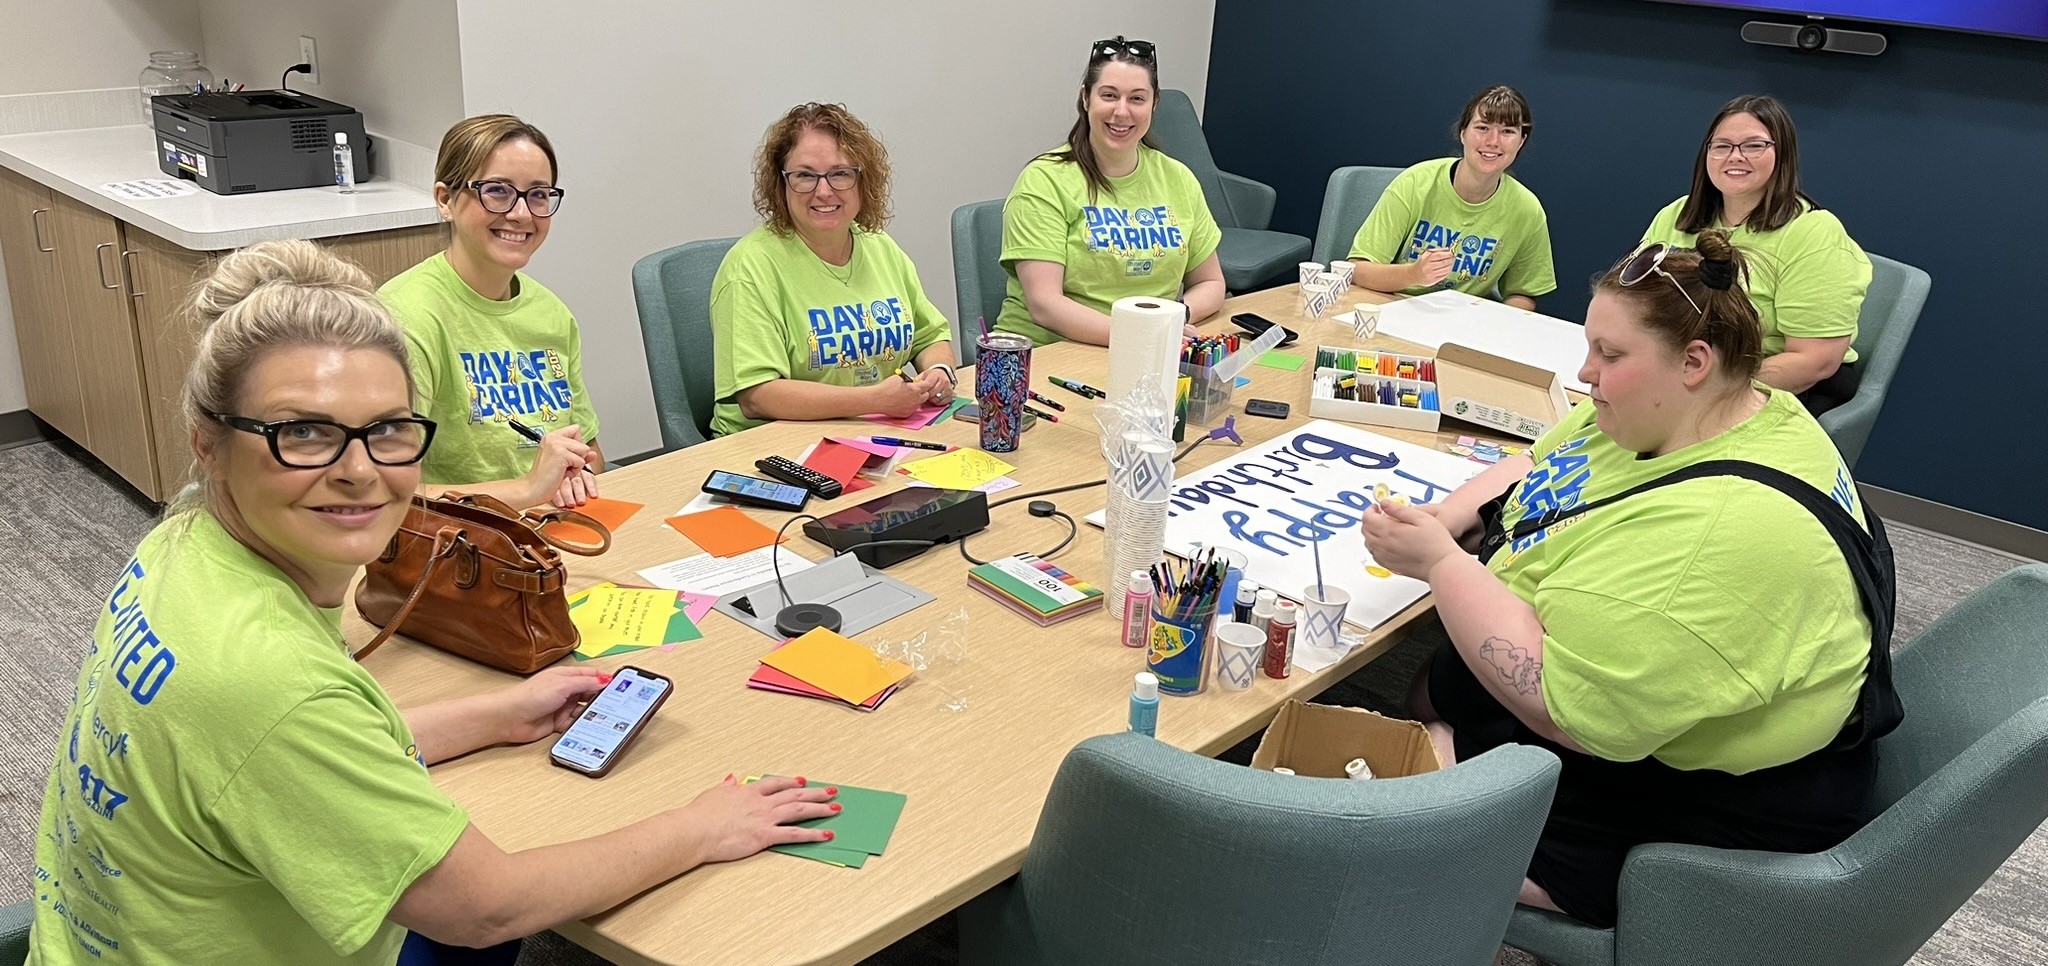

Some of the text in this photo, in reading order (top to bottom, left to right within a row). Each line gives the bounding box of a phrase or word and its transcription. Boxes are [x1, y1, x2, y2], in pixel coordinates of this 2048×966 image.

[1083, 205, 1131, 227] DAY
[1416, 219, 1462, 248] DAY
[1091, 226, 1183, 250] CARING
[808, 303, 866, 336] DAY
[817, 323, 913, 366] CARING
[459, 350, 514, 386] DAY
[476, 379, 573, 418] CARING
[1167, 432, 1400, 517] Birthda
[1222, 468, 1452, 556] Happy
[1038, 579, 1063, 593] 100
[79, 764, 129, 813] 417
